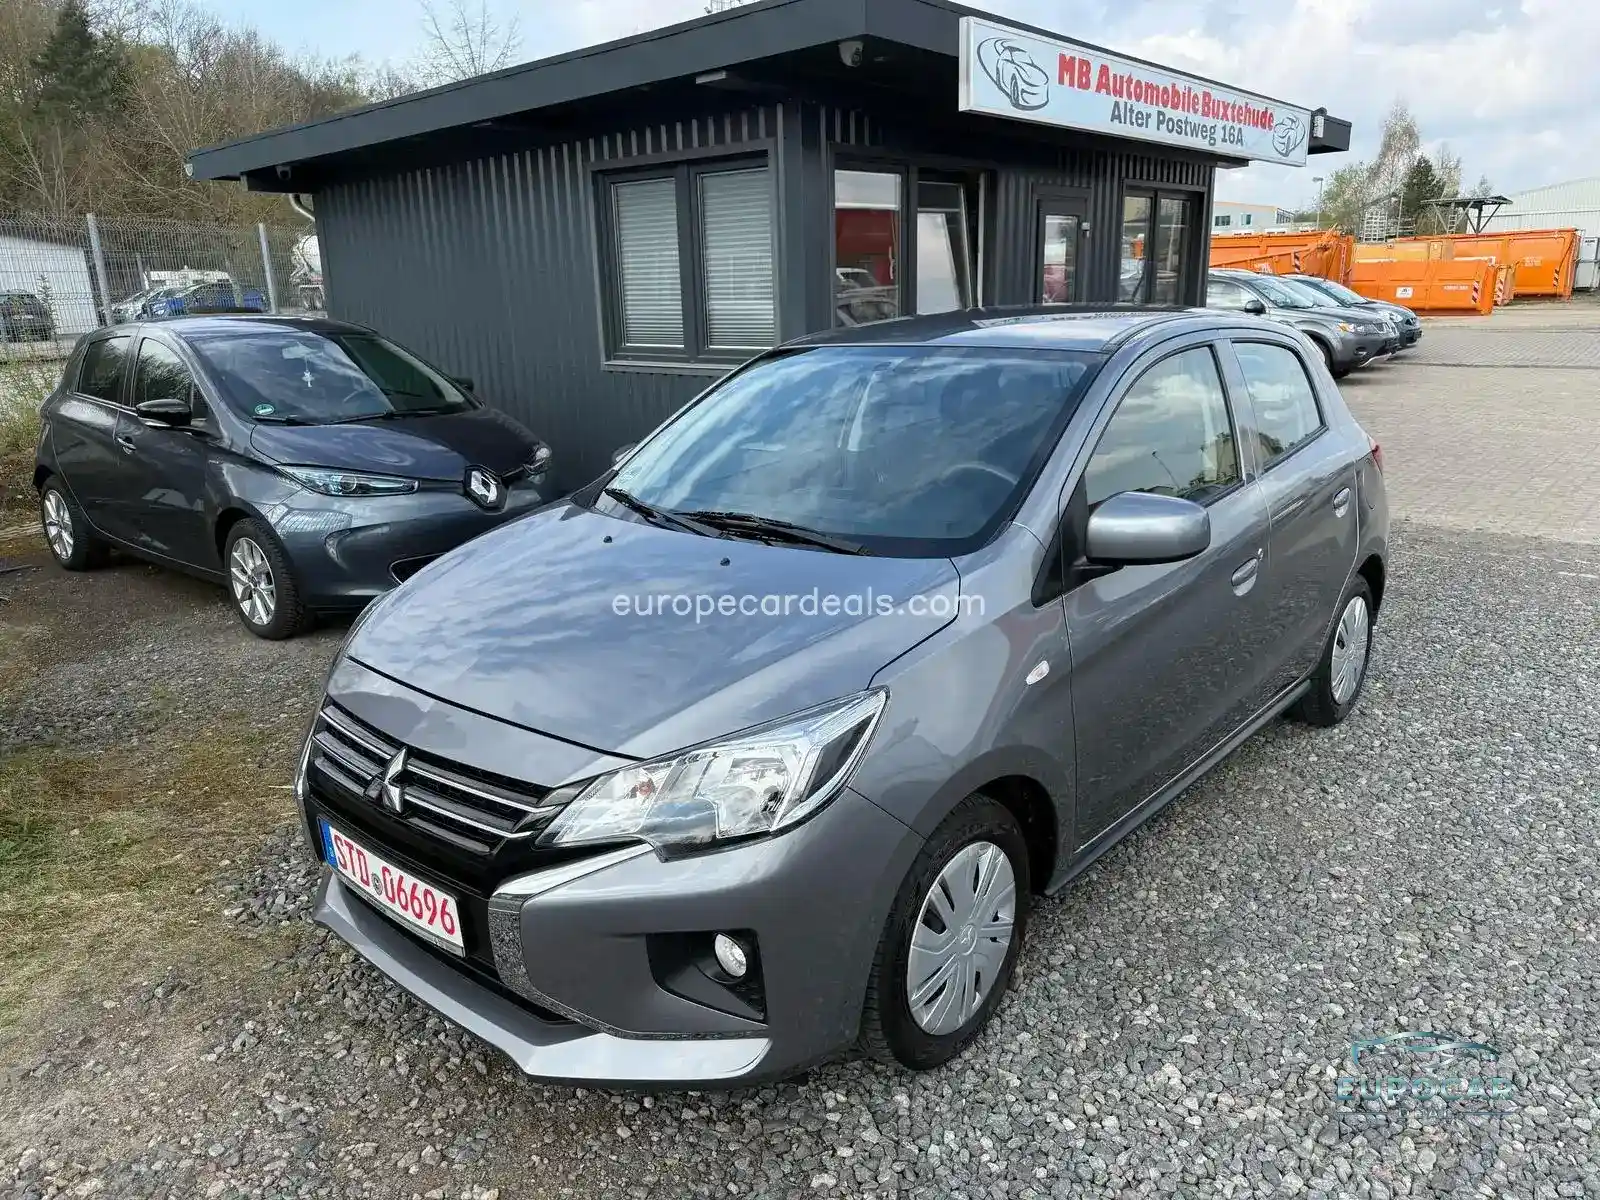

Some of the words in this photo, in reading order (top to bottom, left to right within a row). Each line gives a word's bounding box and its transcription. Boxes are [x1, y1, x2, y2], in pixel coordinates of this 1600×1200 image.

[1058, 53, 1092, 90] MB
[1110, 100, 1152, 128] Alter
[1156, 110, 1217, 146] Postweg
[1221, 124, 1244, 146] 16A
[333, 834, 371, 887] STD
[381, 866, 456, 936] 06696
